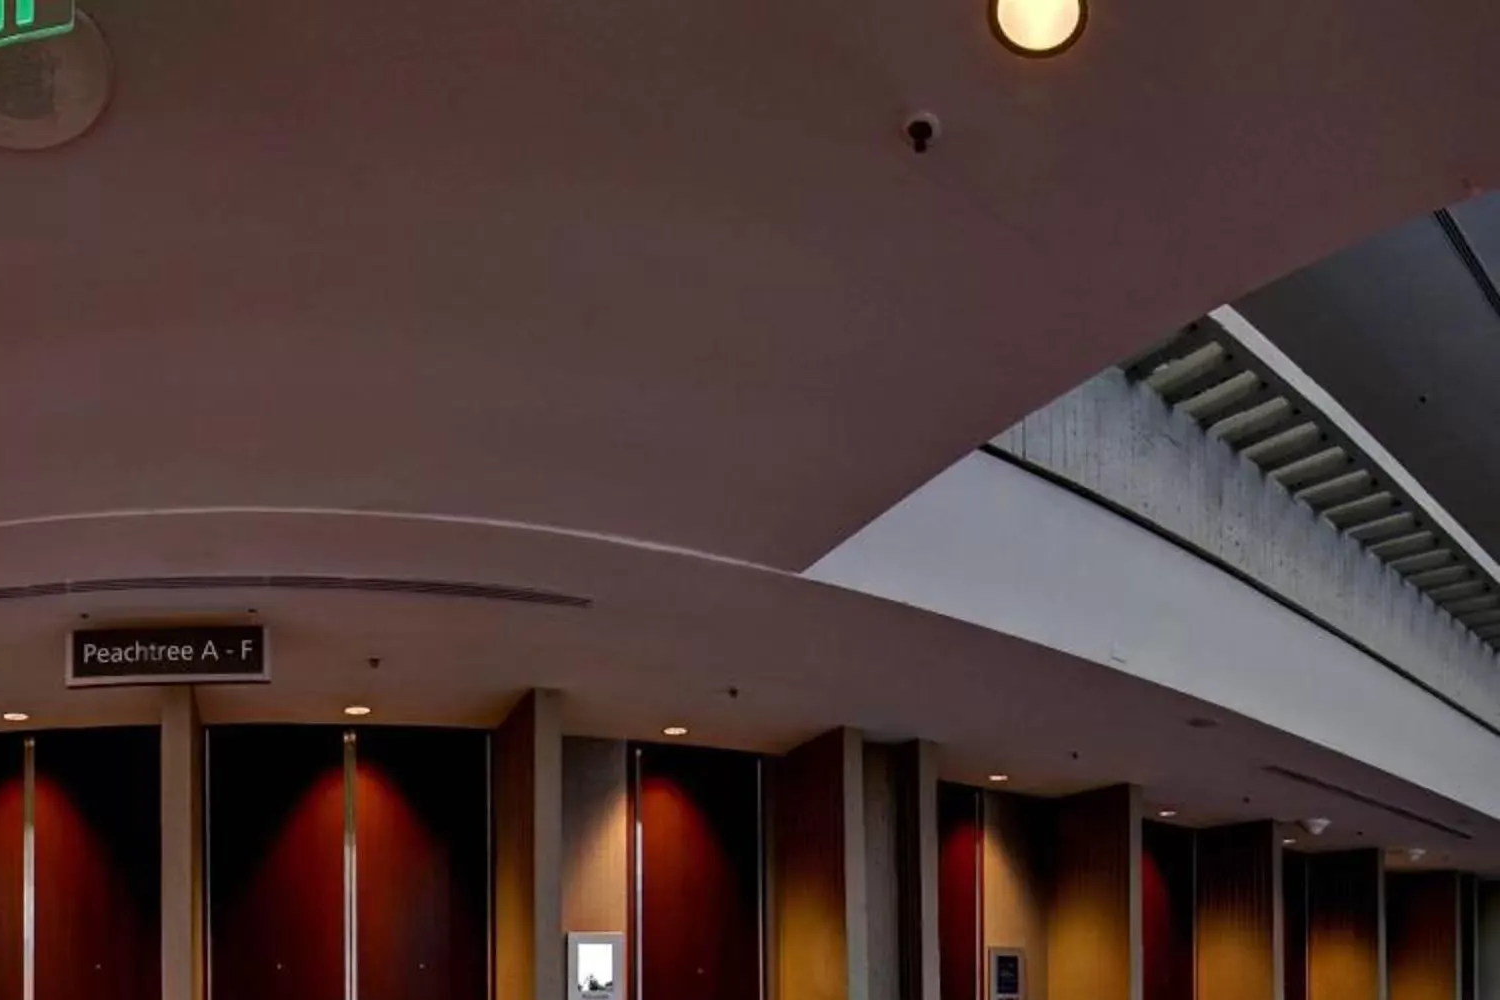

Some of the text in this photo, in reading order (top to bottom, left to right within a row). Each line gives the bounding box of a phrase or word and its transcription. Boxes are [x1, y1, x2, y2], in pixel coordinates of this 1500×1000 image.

[83, 641, 193, 664] Peachtree
[201, 640, 219, 661] A
[241, 640, 253, 660] F
